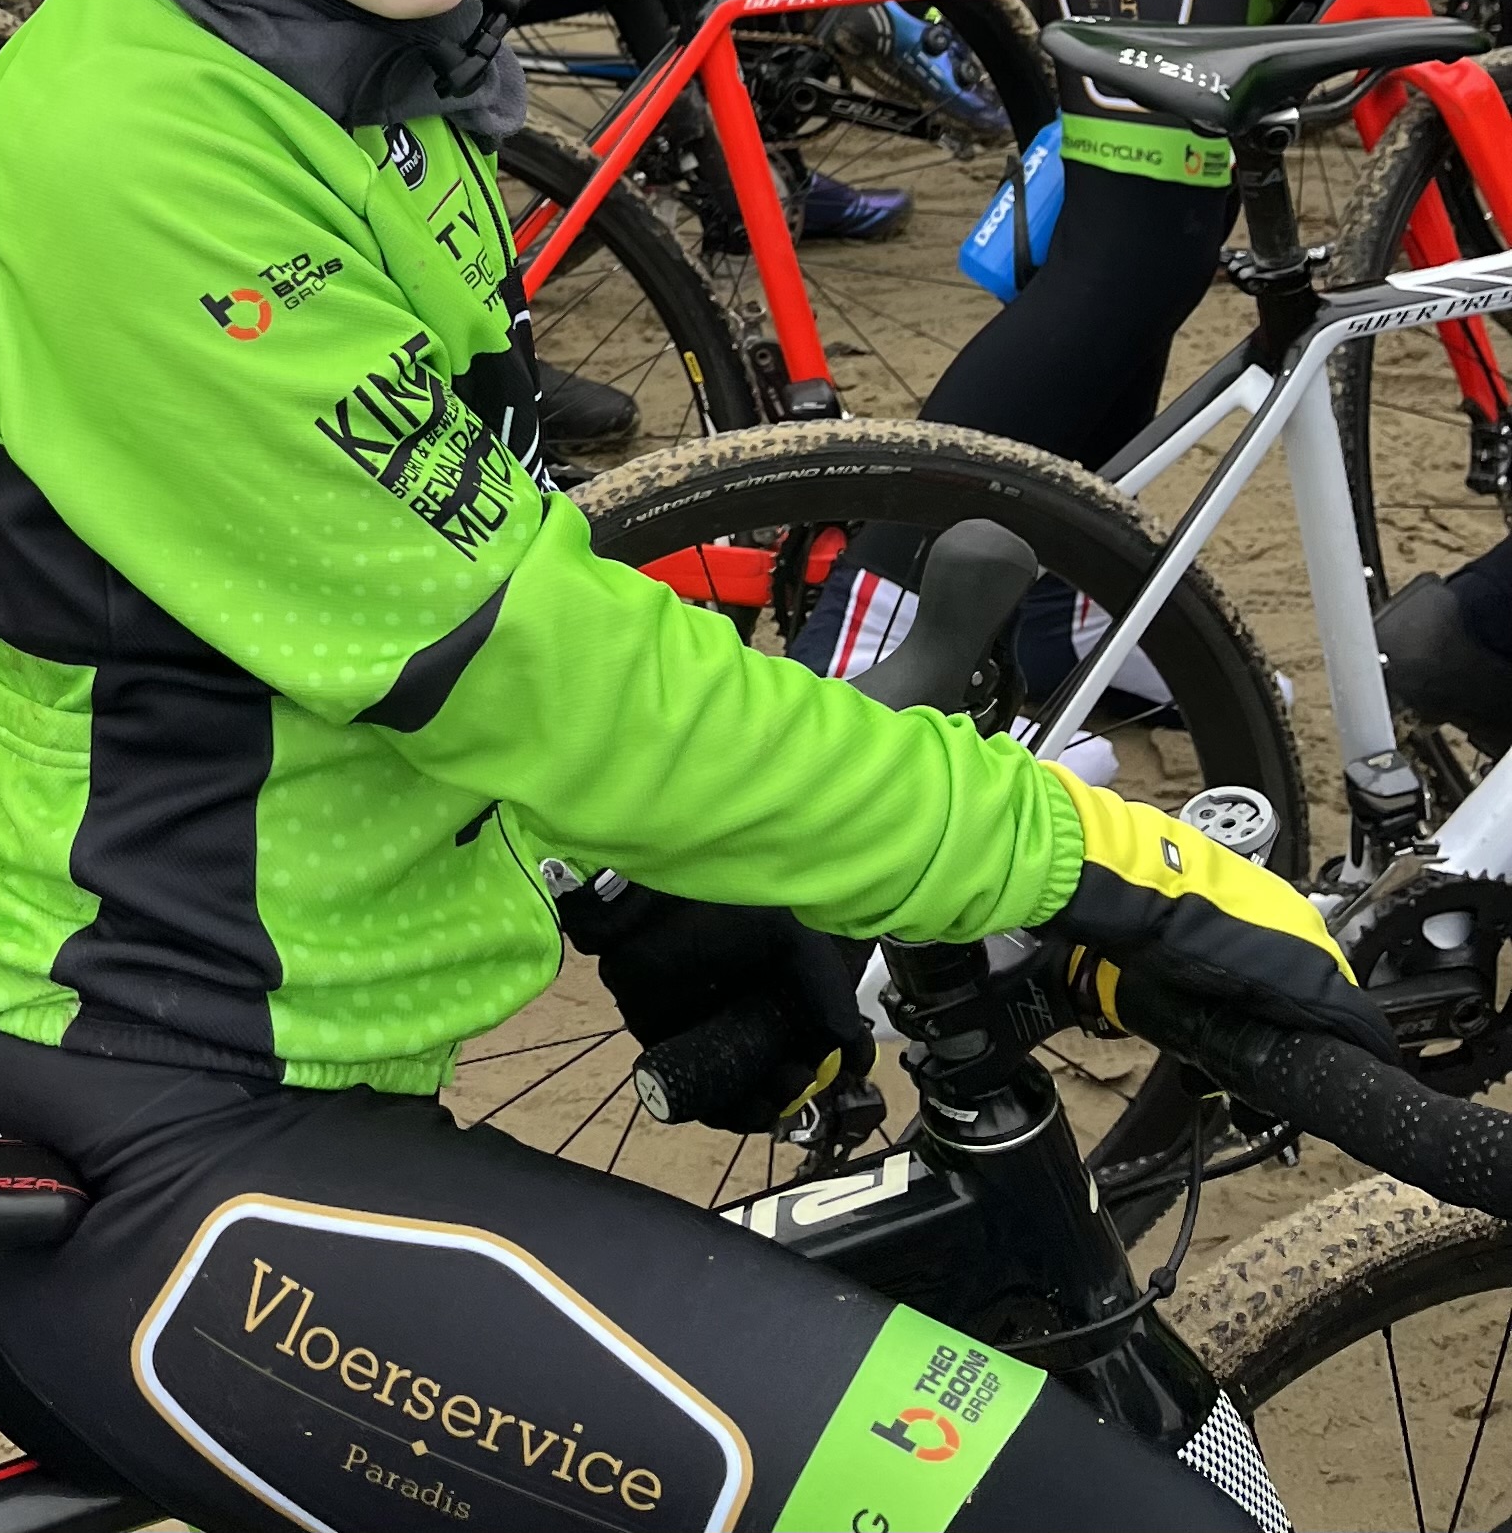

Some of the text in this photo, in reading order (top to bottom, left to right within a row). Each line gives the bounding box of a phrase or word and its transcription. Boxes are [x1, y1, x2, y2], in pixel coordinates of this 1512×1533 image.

[1099, 142, 1163, 166] CYCLING
[1347, 305, 1439, 332] SUPER
[823, 464, 868, 477] MIX
[244, 1256, 665, 1514] Vloerservice
[914, 1344, 958, 1395] THEO
[938, 1348, 990, 1412] BOONS
[960, 1371, 1001, 1424] GROEP
[340, 1442, 474, 1523] Paradis
